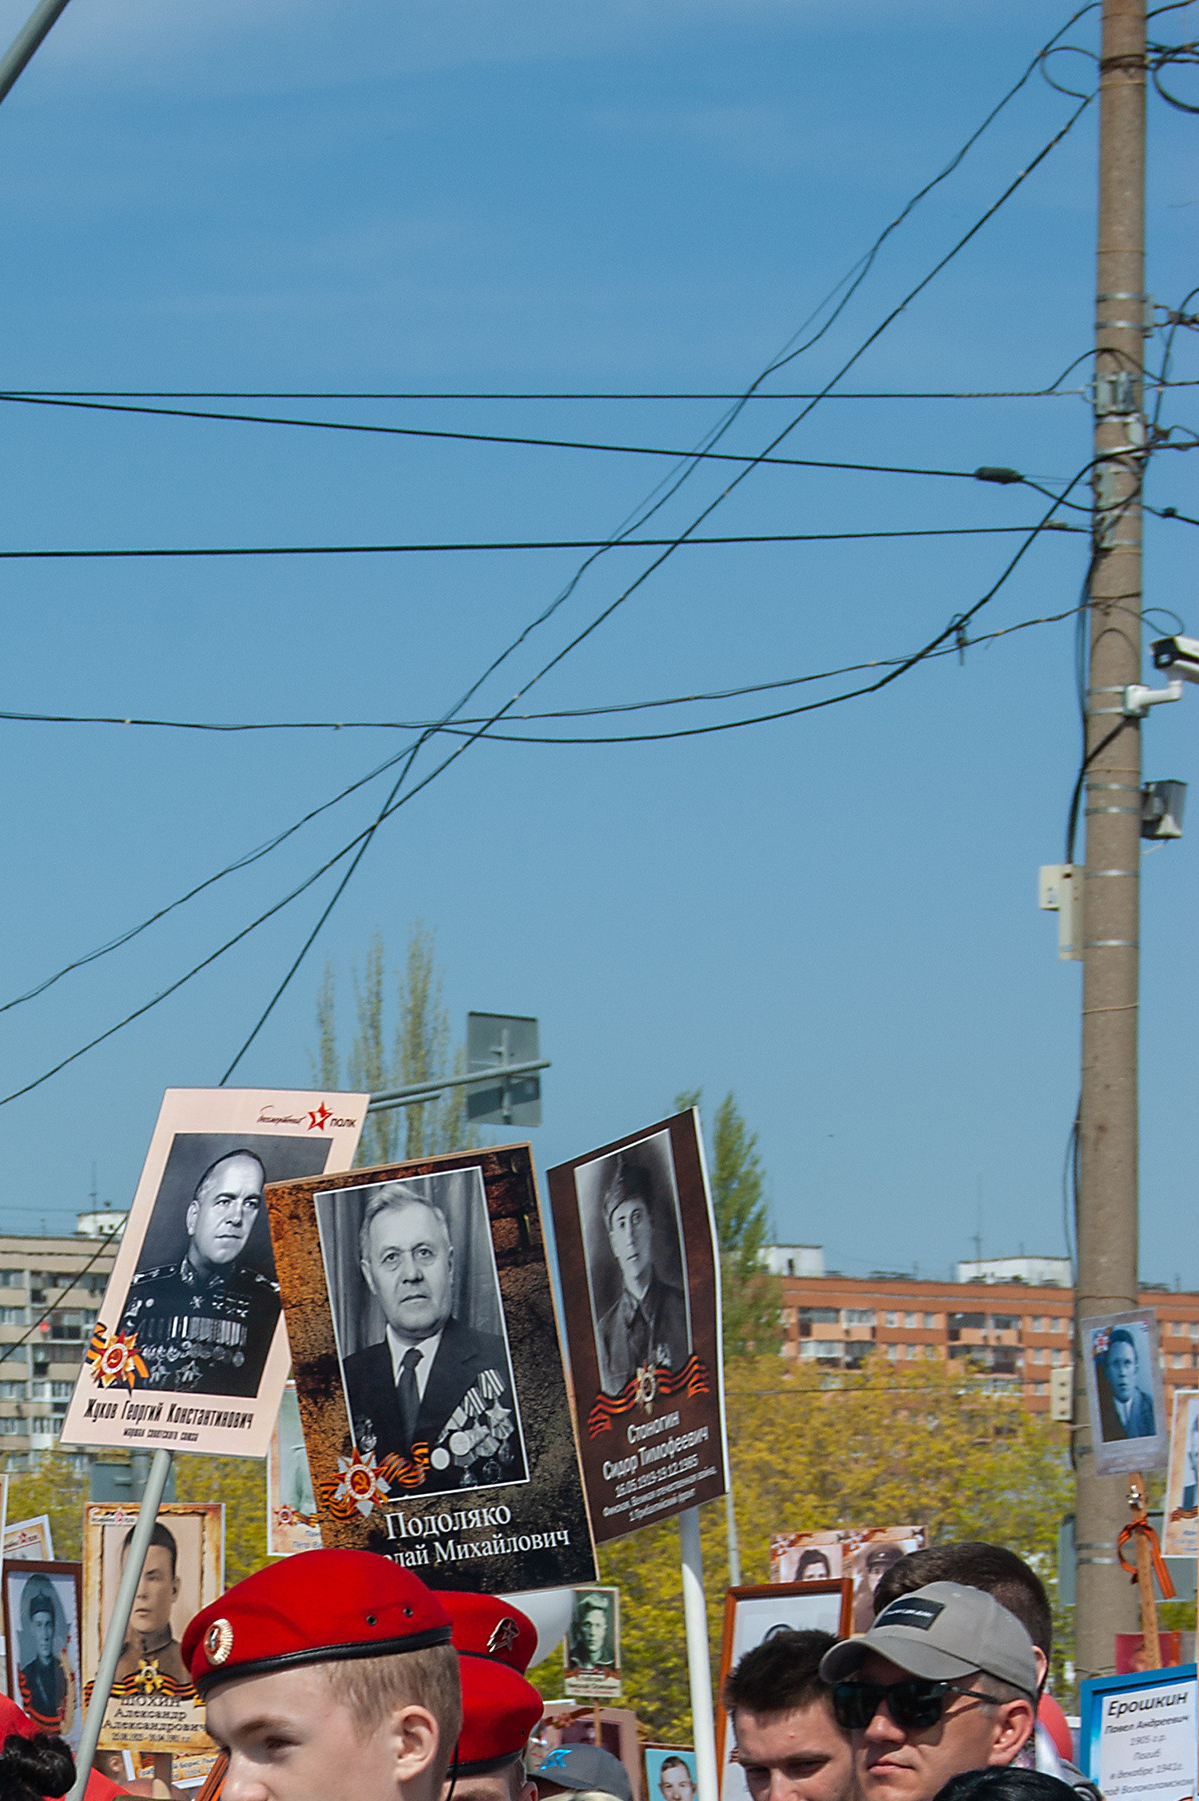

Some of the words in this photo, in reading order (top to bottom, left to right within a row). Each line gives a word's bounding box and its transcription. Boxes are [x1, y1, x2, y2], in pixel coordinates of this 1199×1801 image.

[84, 1399, 118, 1422] Жуков
[120, 1400, 164, 1425] Георгий
[166, 1403, 254, 1429] Константинович
[603, 1454, 639, 1480] Сидор
[638, 1425, 709, 1466] Тимофеевич
[384, 1504, 512, 1541] Подоляко
[433, 1530, 571, 1563] Михайлович
[114, 1708, 187, 1721] Александр
[1108, 1692, 1188, 1718] Ерошкин
